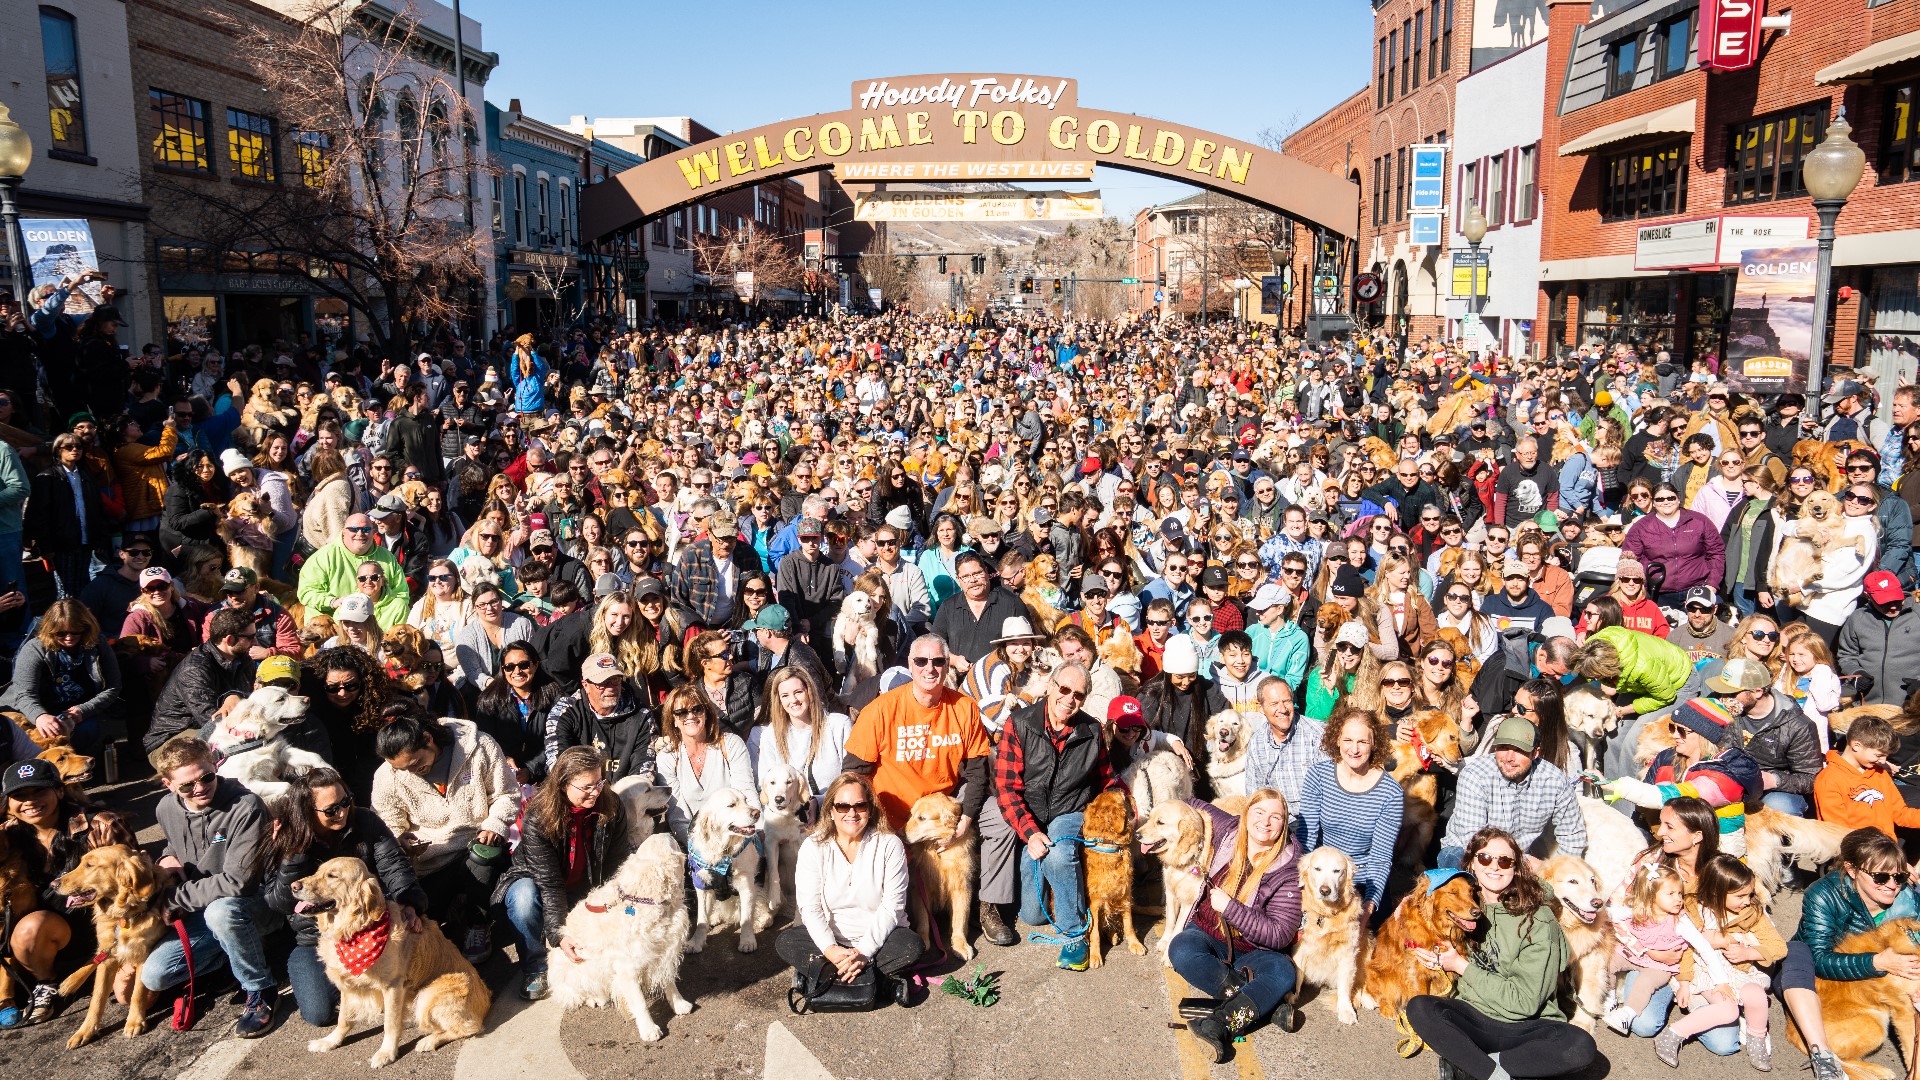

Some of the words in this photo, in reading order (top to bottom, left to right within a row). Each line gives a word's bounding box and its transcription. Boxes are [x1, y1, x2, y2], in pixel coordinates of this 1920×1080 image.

[859, 79, 966, 109] Howdy
[970, 77, 1068, 109] Folks!
[676, 110, 934, 190] WELCOME
[953, 109, 1025, 145] TO
[1048, 115, 1255, 186] GOLDEN
[844, 164, 915, 177] WHERE
[922, 163, 960, 177] THE
[967, 163, 1024, 176] WEST
[1029, 163, 1085, 176] LIVES
[891, 194, 965, 206] GOLDENS
[892, 208, 907, 218] IN
[912, 207, 964, 218] GOLDEN
[26, 230, 88, 242] GOLDEN
[1640, 227, 1671, 241] HOMESLICE
[1705, 221, 1716, 234] FRI
[1731, 228, 1744, 236] THE
[1753, 228, 1771, 236] ROSE
[525, 252, 548, 266] BRICK
[1744, 262, 1811, 277] GOLDEN
[228, 278, 249, 288] BABY
[1748, 360, 1789, 370] GOLDEN
[897, 724, 933, 738] BEST.
[896, 737, 928, 750] DOG
[931, 733, 962, 748] DAD
[896, 748, 937, 762] EVER.
